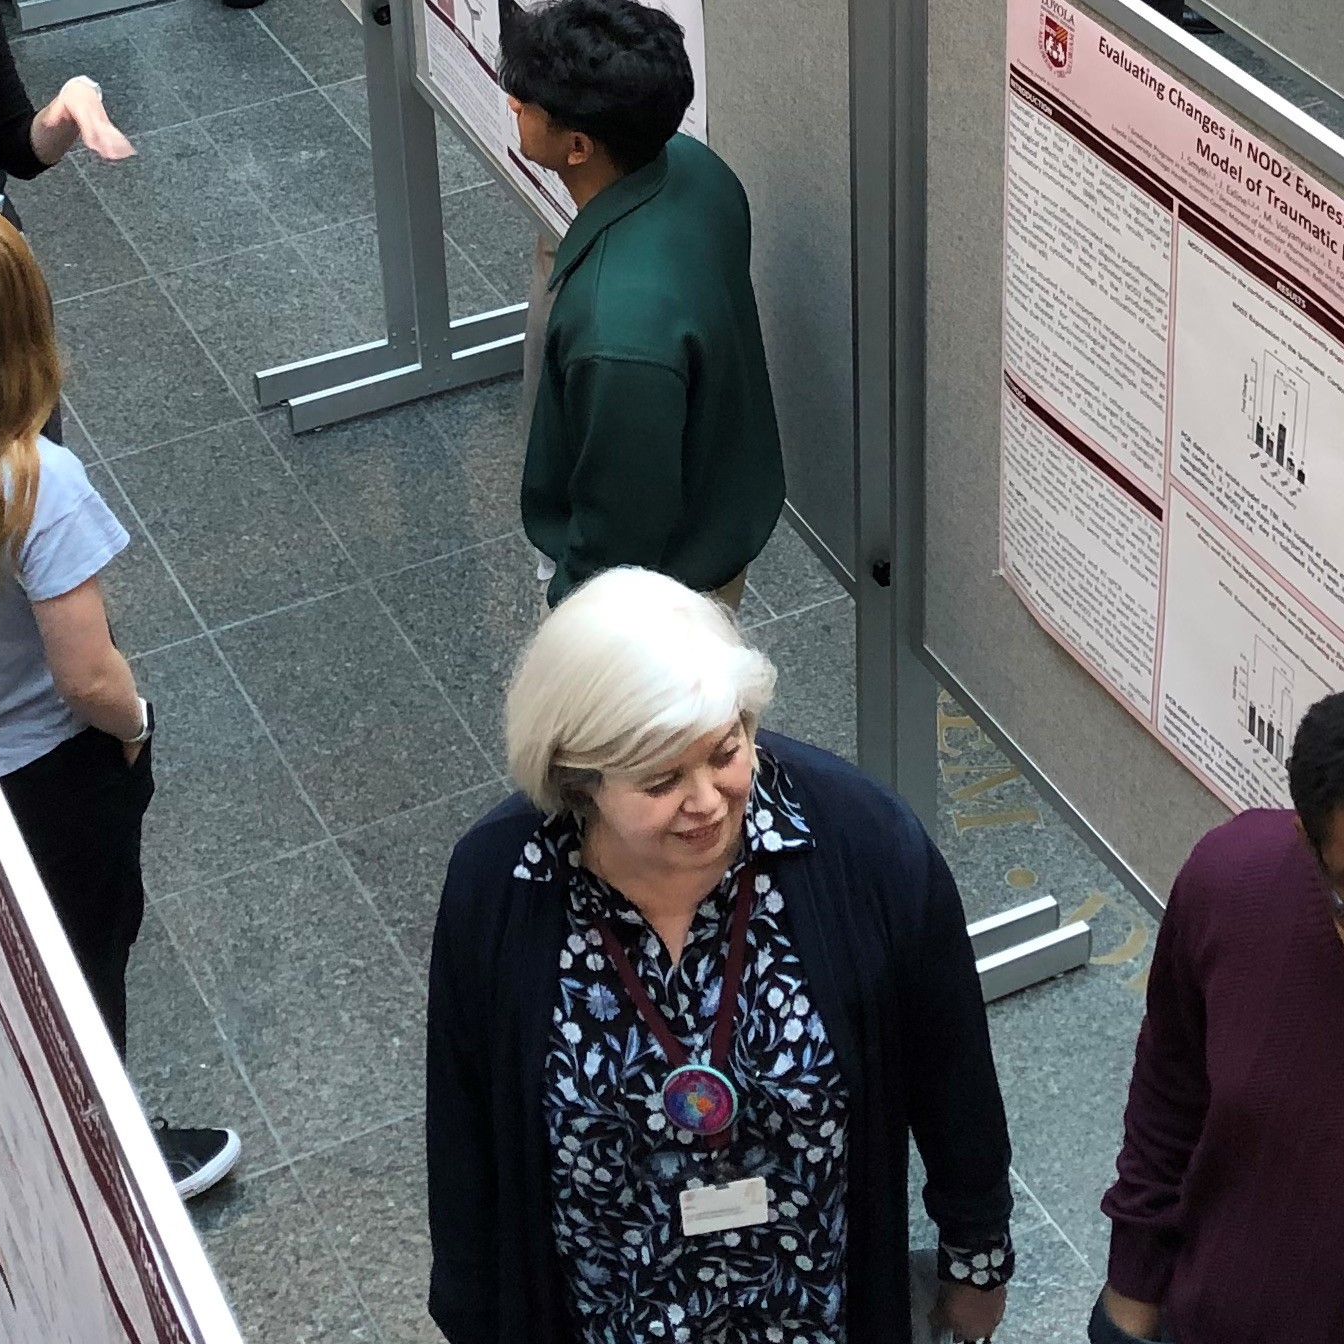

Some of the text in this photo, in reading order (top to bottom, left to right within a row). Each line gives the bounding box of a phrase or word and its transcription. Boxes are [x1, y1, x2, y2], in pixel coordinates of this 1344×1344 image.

[1098, 36, 1163, 100] Evaluating
[1168, 87, 1225, 140] Changes
[1229, 129, 1242, 153] in
[1246, 142, 1292, 186] NOD2
[1196, 137, 1241, 183] Model
[1246, 177, 1261, 196] of
[1265, 185, 1337, 254] Traumatic
[1276, 281, 1305, 308] RESULTS
